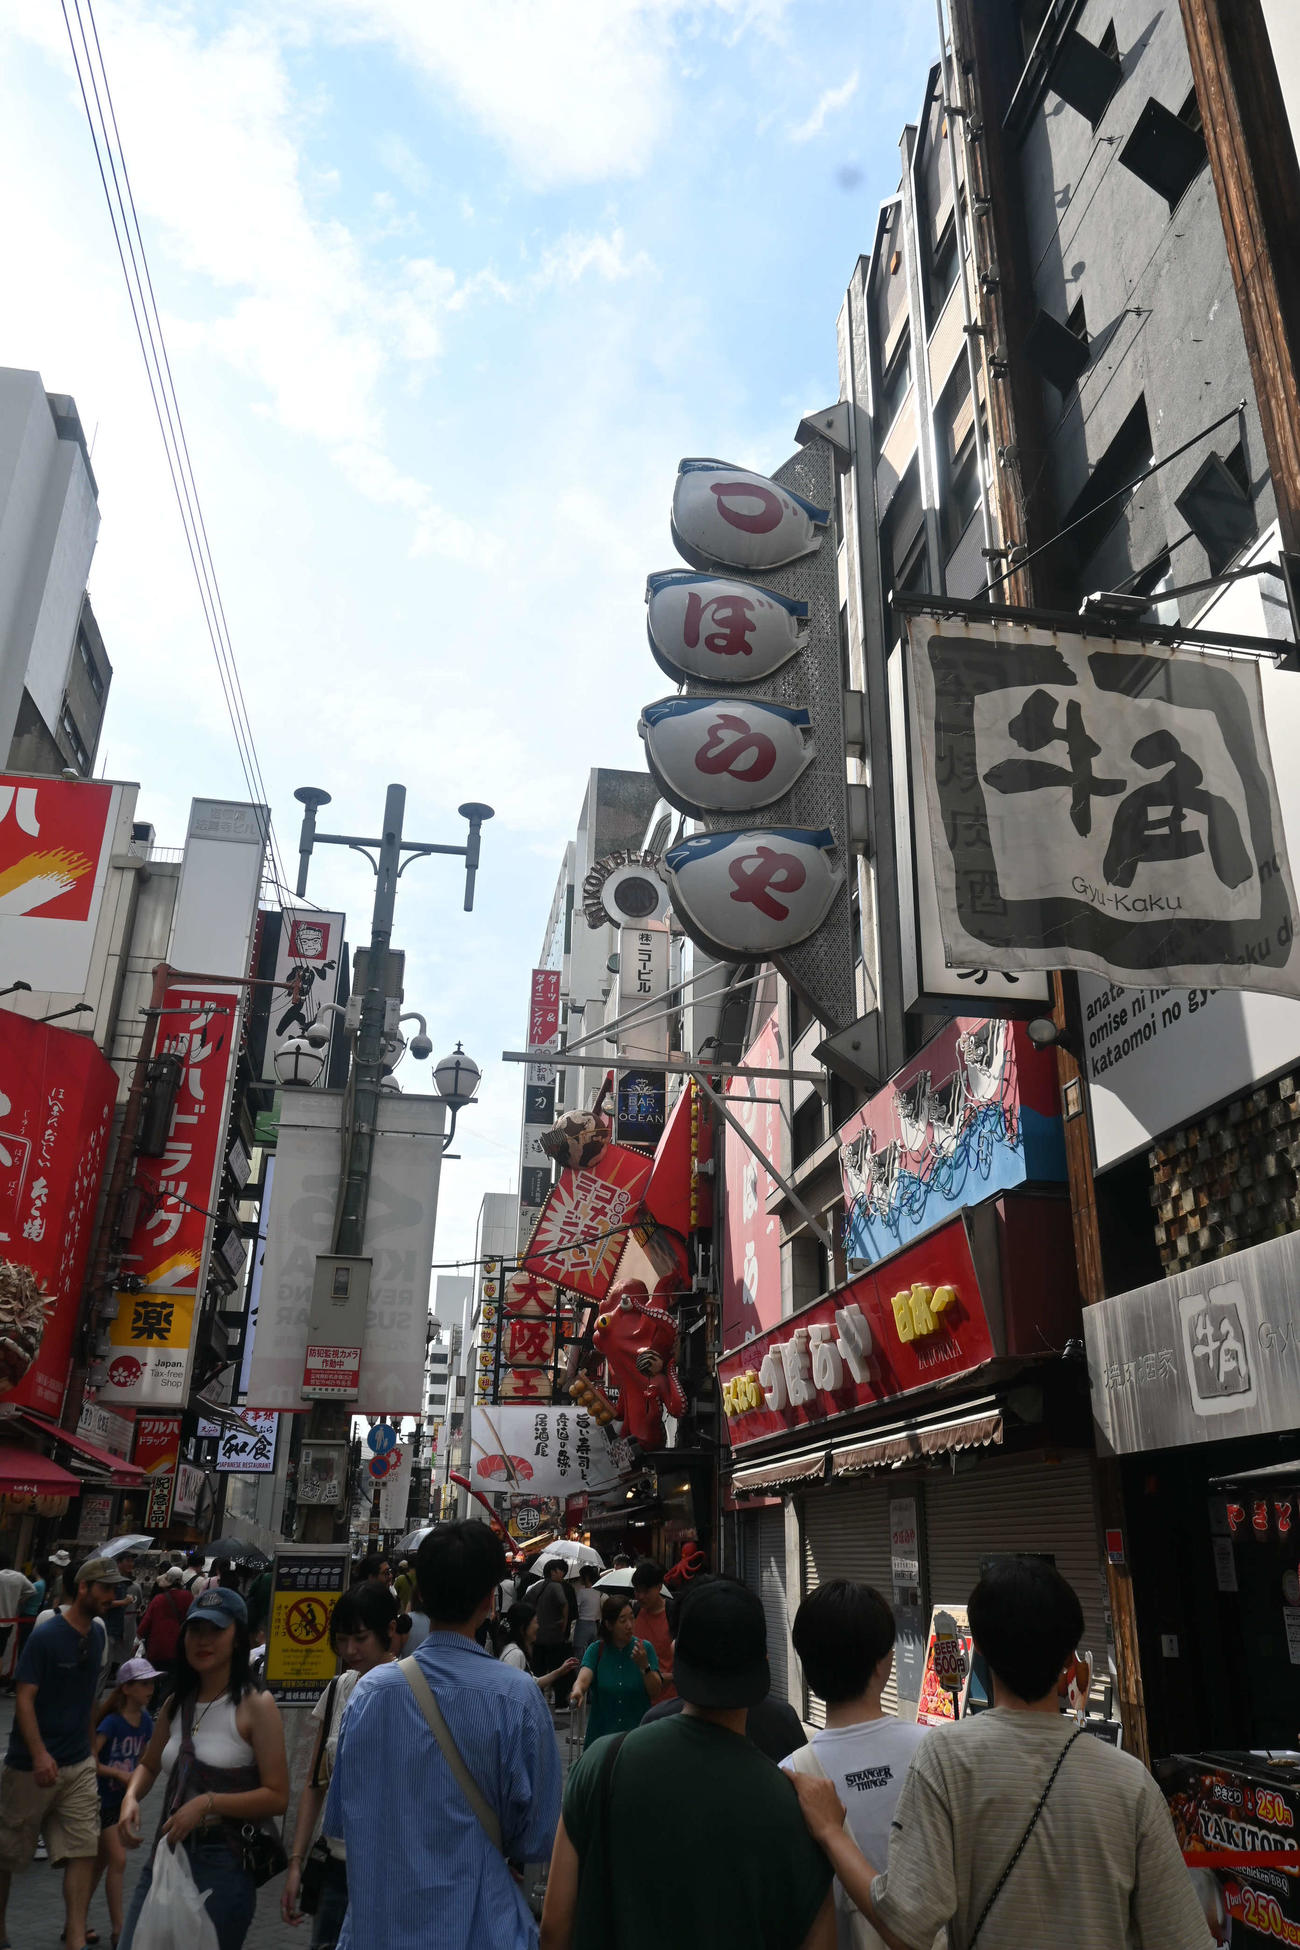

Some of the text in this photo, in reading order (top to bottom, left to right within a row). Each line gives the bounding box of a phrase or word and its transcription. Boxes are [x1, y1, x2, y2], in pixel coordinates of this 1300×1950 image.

[983, 688, 1253, 889] 牛角
[1071, 876, 1183, 913] Gyu-Kaku
[1087, 983, 1125, 1021] anata
[1090, 1008, 1128, 1048] omise
[1133, 992, 1146, 1018] ni
[1092, 1016, 1157, 1077] kataomoi
[1162, 1003, 1181, 1028] no
[628, 1096, 655, 1107] BAR
[619, 1112, 664, 1124] OCEAN
[131, 1300, 174, 1340] 薬
[503, 1274, 555, 1405] 大阪王
[154, 1359, 184, 1368] Japan.
[309, 1349, 358, 1359] 防犯監視カメラ
[321, 1359, 344, 1368] 作動中
[759, 1304, 872, 1411] づぼらや
[151, 1369, 183, 1378] Tax-free
[160, 1379, 182, 1388] Shop
[141, 1421, 179, 1435] ツルハ
[534, 1413, 550, 1458] 居酒屋
[139, 1436, 171, 1446] ドラッグ
[221, 1434, 273, 1460] 和食
[218, 1461, 272, 1470] JAPANESE RESTAURANT
[1226, 1500, 1300, 1532] やきと
[934, 1640, 958, 1656] BEER
[934, 1655, 966, 1676] 500円
[845, 1765, 893, 1787] STRANGER
[856, 1778, 888, 1791] THINGS
[1214, 1786, 1242, 1804] やきとり
[1257, 1788, 1292, 1825] 250円
[1271, 1874, 1289, 1893] BBQ
[1243, 1888, 1282, 1934] 250
